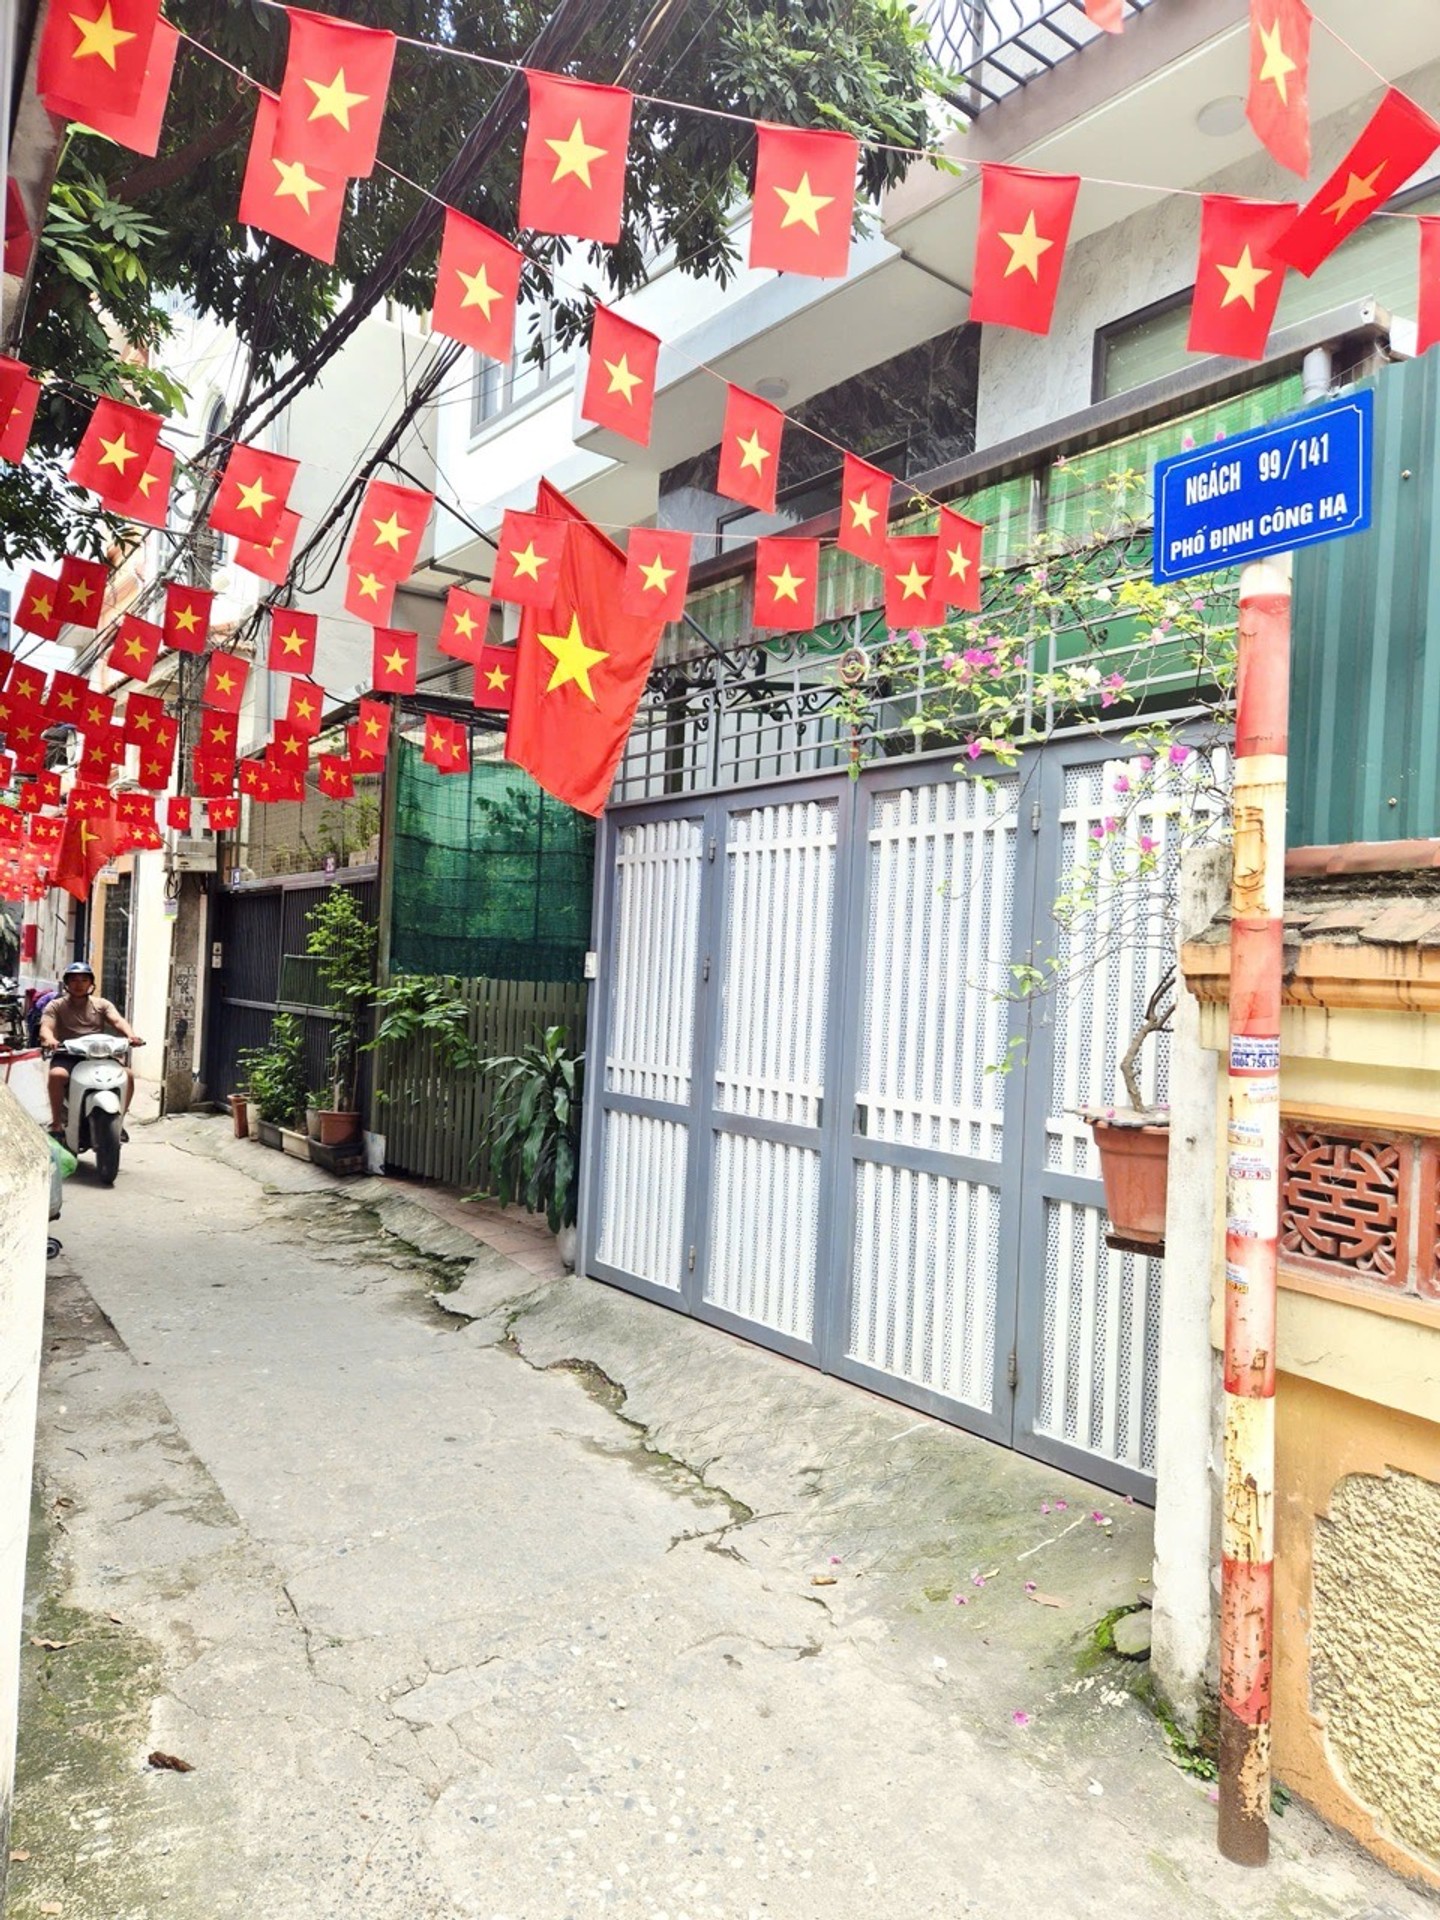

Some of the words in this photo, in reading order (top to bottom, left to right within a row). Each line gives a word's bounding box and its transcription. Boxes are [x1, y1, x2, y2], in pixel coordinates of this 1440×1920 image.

[1185, 462, 1241, 506] NGÁCH
[1258, 433, 1329, 482] 99/141
[1170, 525, 1207, 561] PHỐ
[1209, 519, 1254, 553] ĐỊNH
[1259, 506, 1314, 537] CÔNG
[1318, 493, 1348, 522] HẠ
